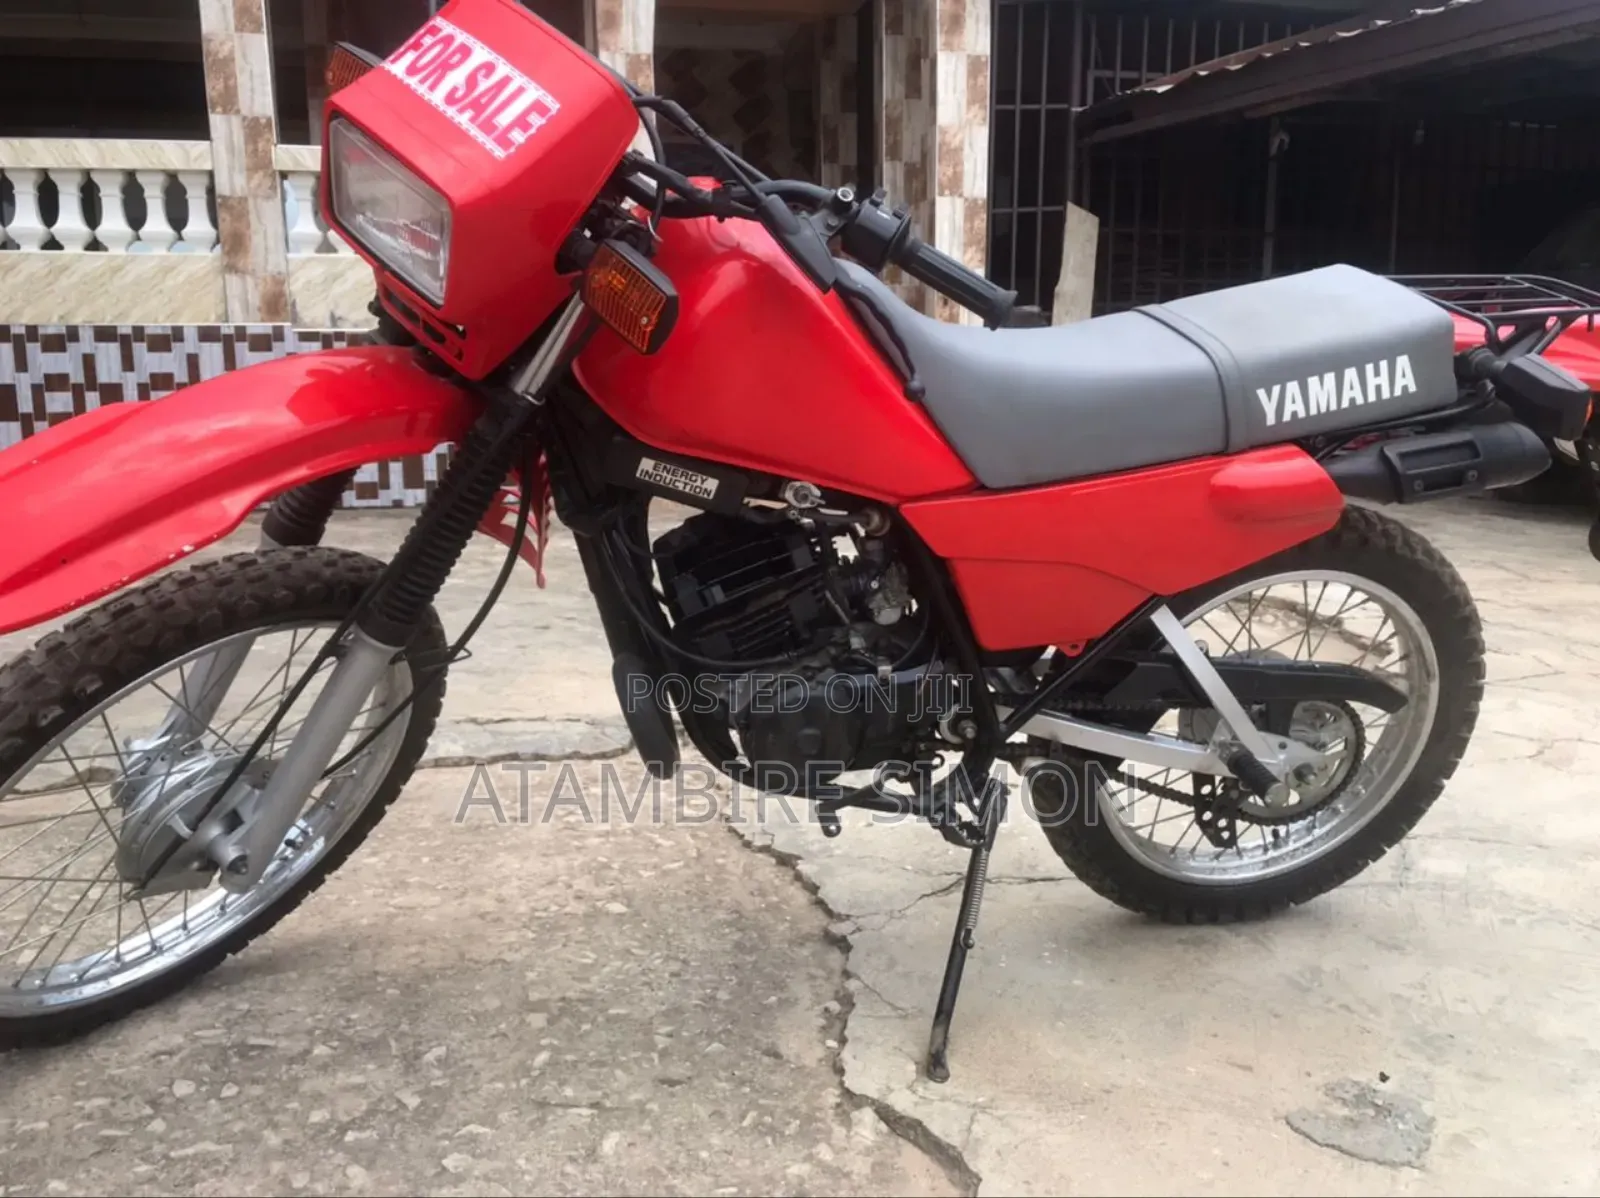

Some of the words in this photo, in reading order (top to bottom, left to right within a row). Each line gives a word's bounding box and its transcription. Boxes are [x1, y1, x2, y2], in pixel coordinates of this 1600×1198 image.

[390, 25, 472, 92] FOR
[445, 61, 552, 151] SALE
[1256, 354, 1417, 425] YAMAHA
[639, 468, 713, 498] INDUCTION
[652, 462, 708, 485] ENERGY
